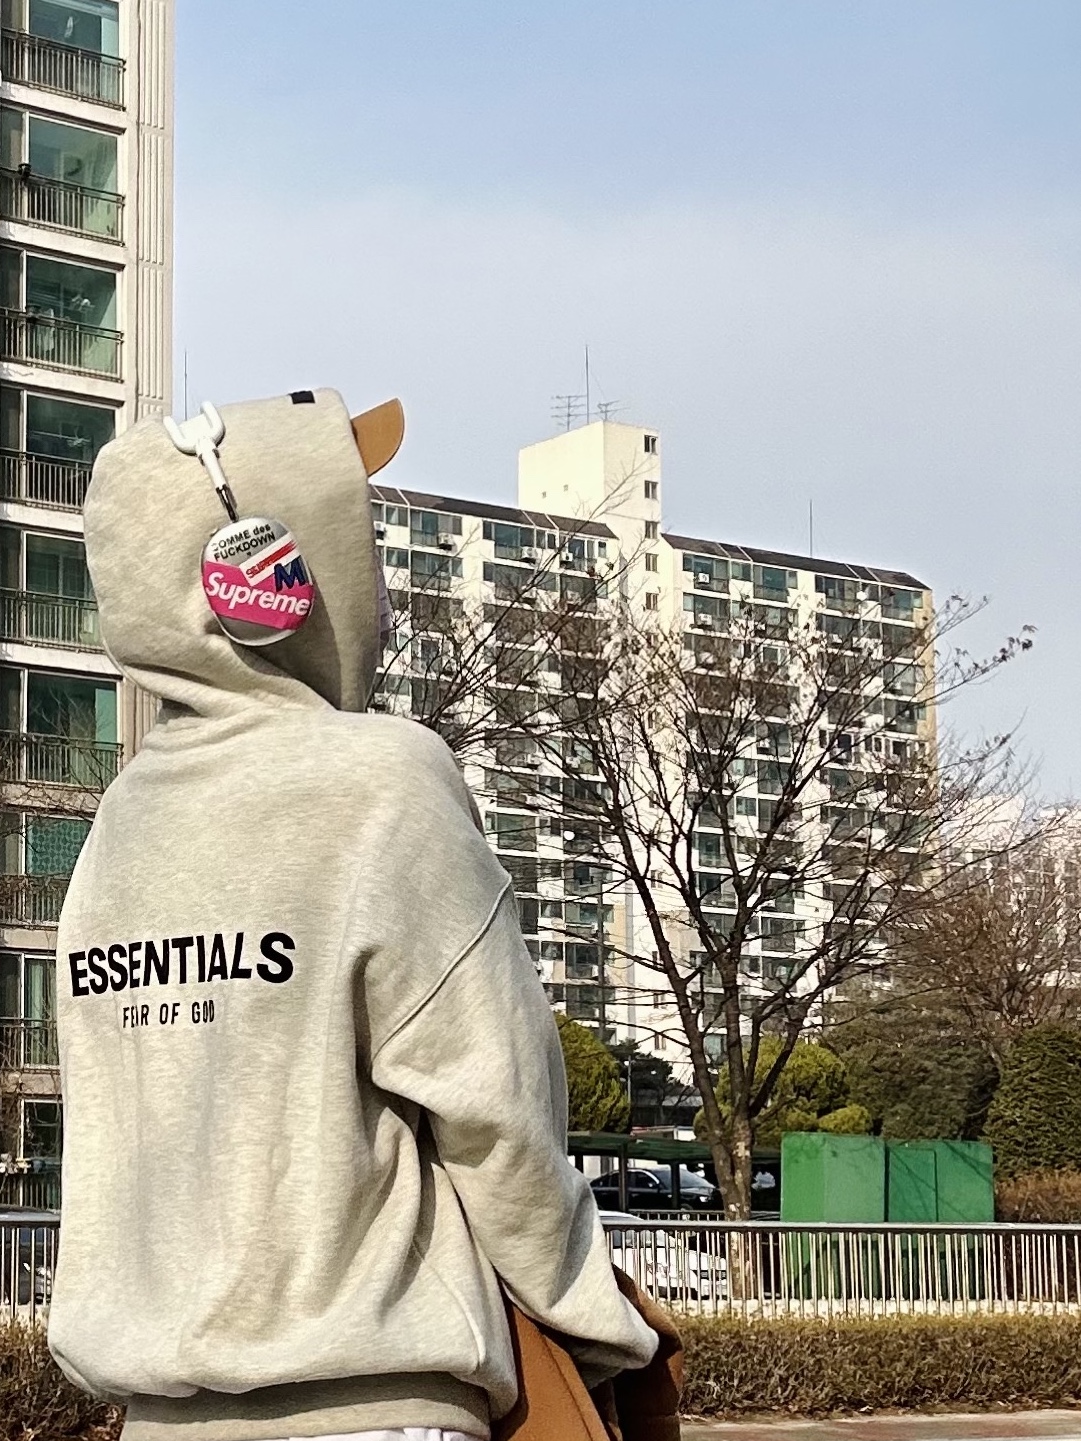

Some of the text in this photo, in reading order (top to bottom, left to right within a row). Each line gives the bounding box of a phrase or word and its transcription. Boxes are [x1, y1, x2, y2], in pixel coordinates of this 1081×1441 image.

[252, 524, 271, 535] des
[214, 532, 276, 562] FUCKDOWN
[205, 571, 310, 616] Supreme
[69, 931, 296, 997] ESSENTIALS
[159, 1003, 180, 1025] OF
[191, 999, 215, 1024] GOD
